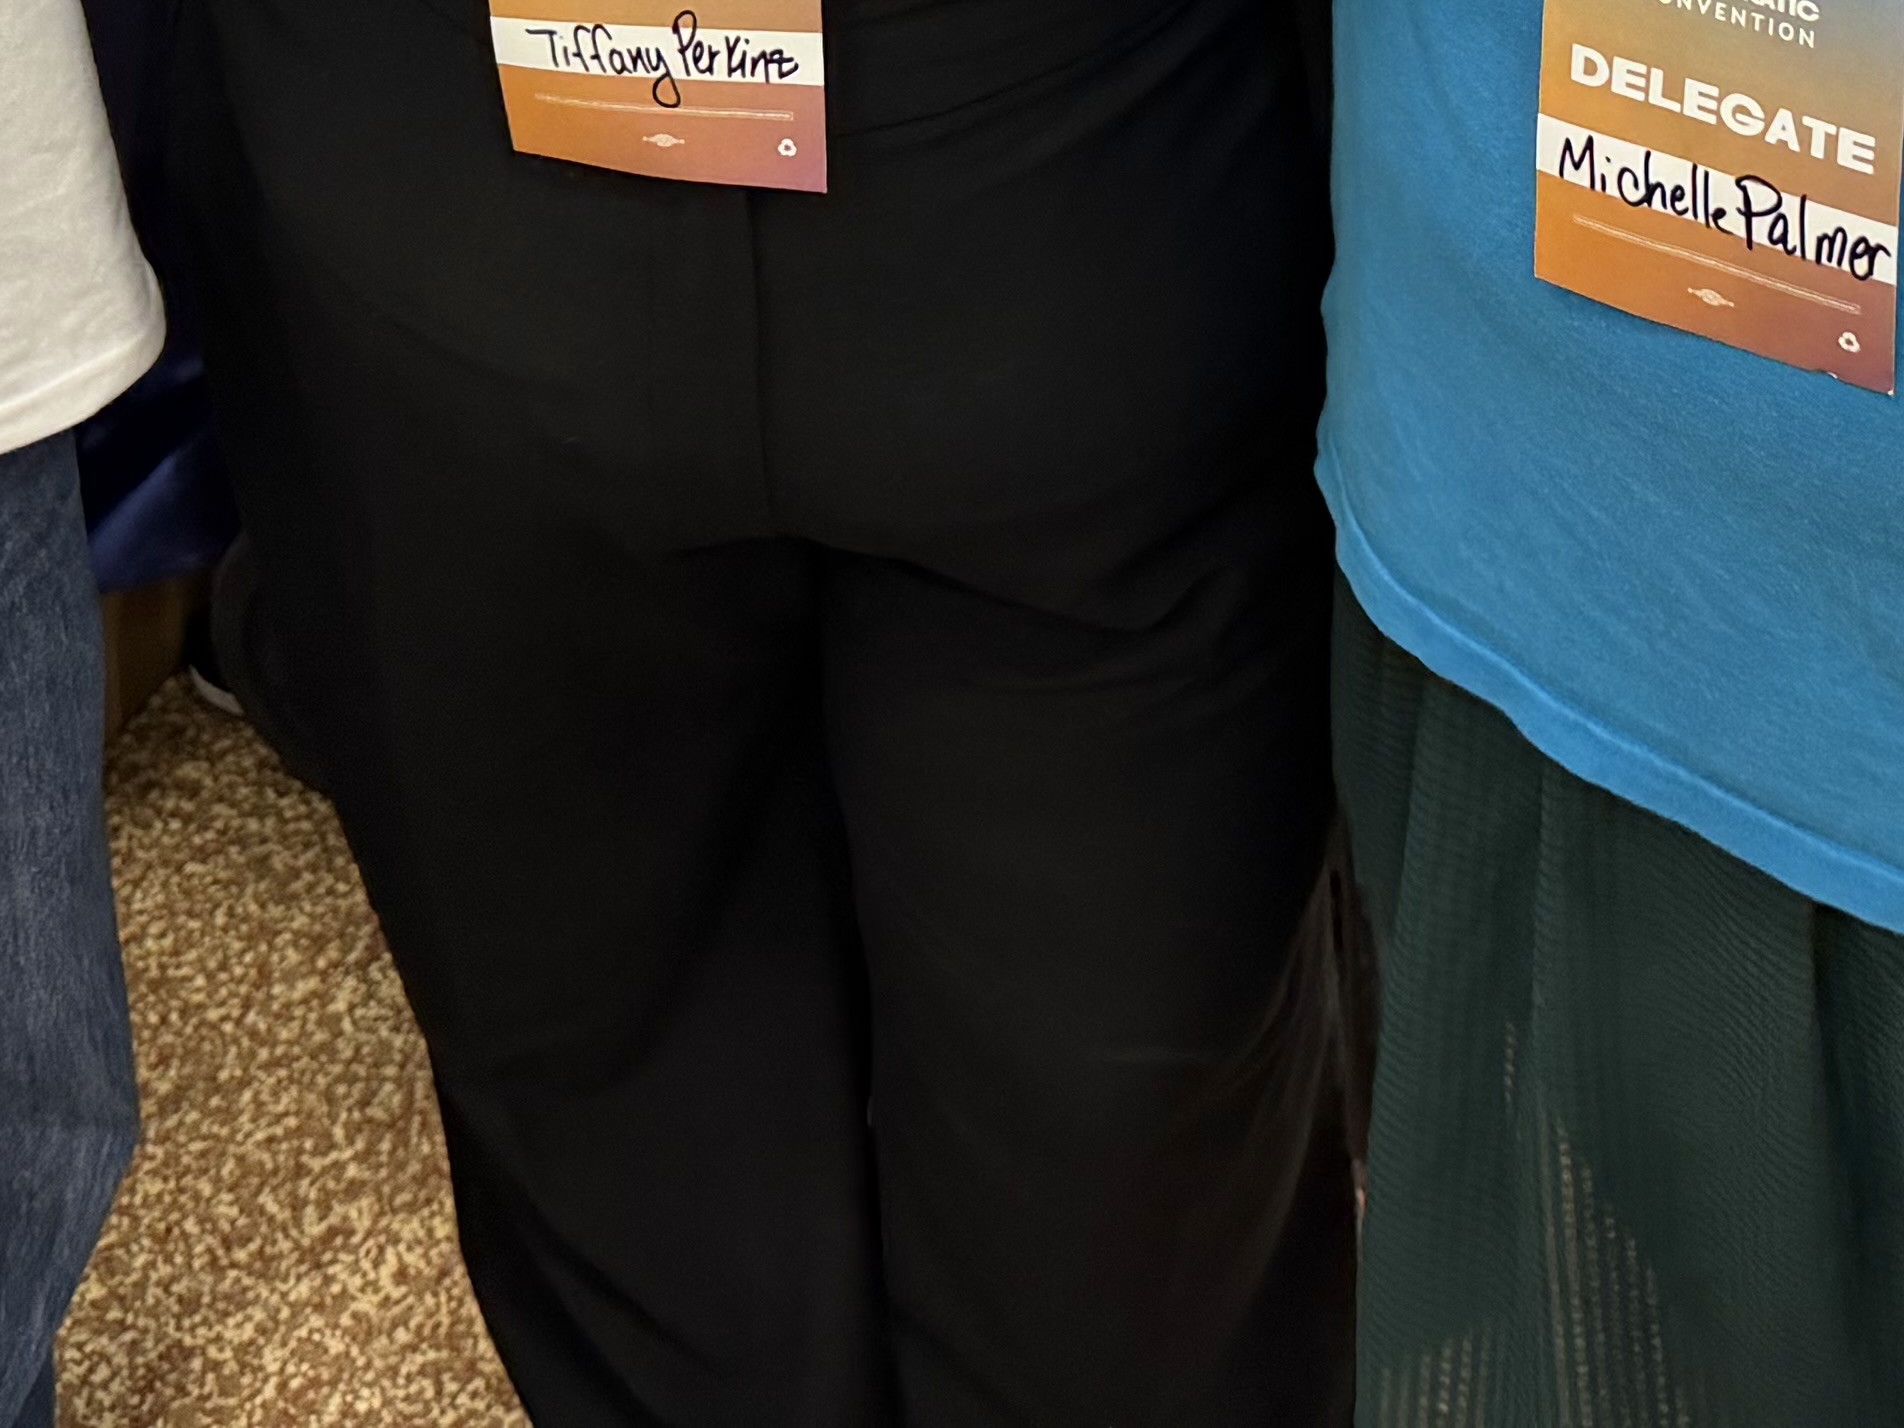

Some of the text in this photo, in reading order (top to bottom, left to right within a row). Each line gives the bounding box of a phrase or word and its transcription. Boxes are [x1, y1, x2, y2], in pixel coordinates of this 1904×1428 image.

[525, 24, 681, 108] Tiffany
[1570, 43, 1875, 175] DELEGATE
[1559, 134, 1734, 235] Michelle
[1734, 175, 1892, 281] Palmer
